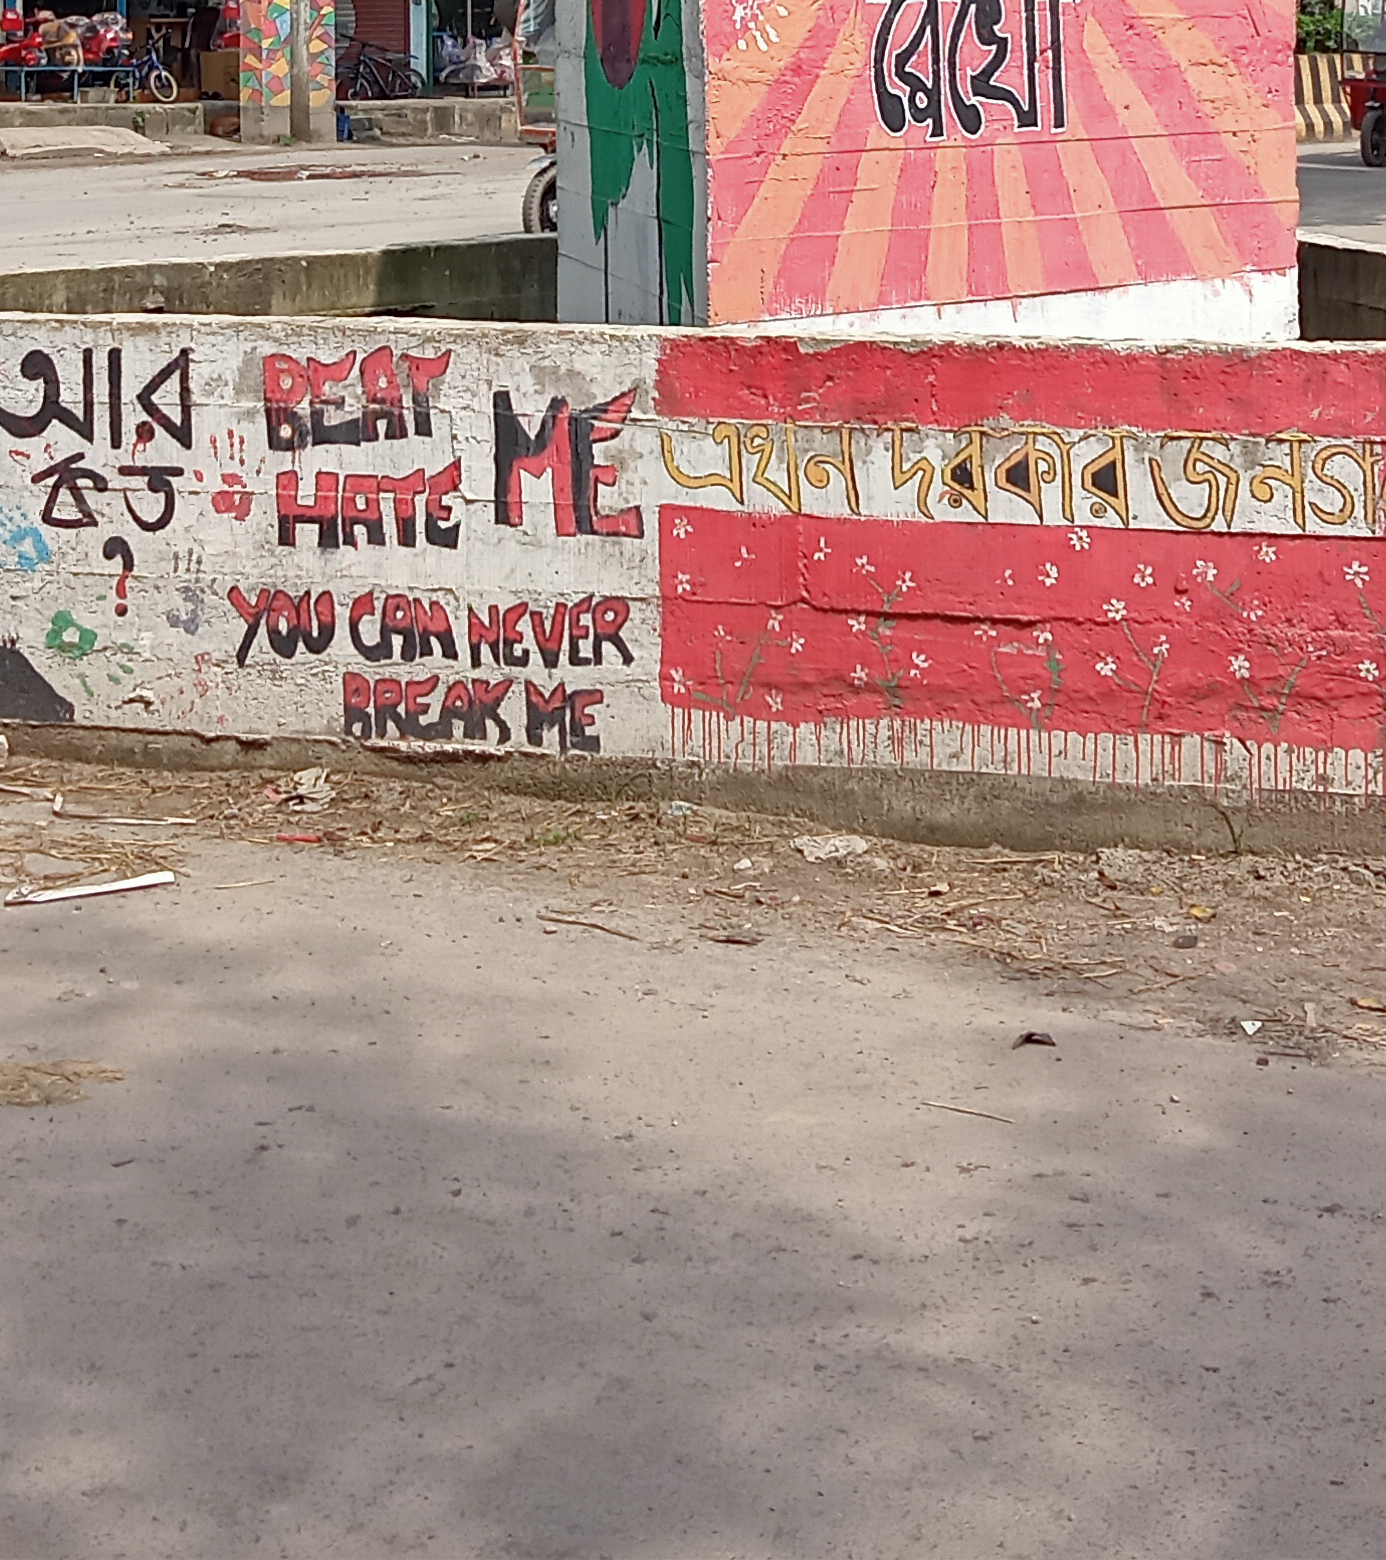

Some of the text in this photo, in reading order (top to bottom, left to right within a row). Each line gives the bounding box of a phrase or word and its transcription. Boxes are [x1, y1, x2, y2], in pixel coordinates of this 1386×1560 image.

[263, 345, 452, 452] BEAT
[30, 451, 185, 532] কত
[275, 456, 463, 550] HATE
[492, 387, 645, 539] ME
[659, 420, 862, 516] এখন
[877, 422, 1137, 529] দরকার
[227, 585, 635, 669] YOU CAN NEVER
[342, 671, 604, 755] BREAK ME
